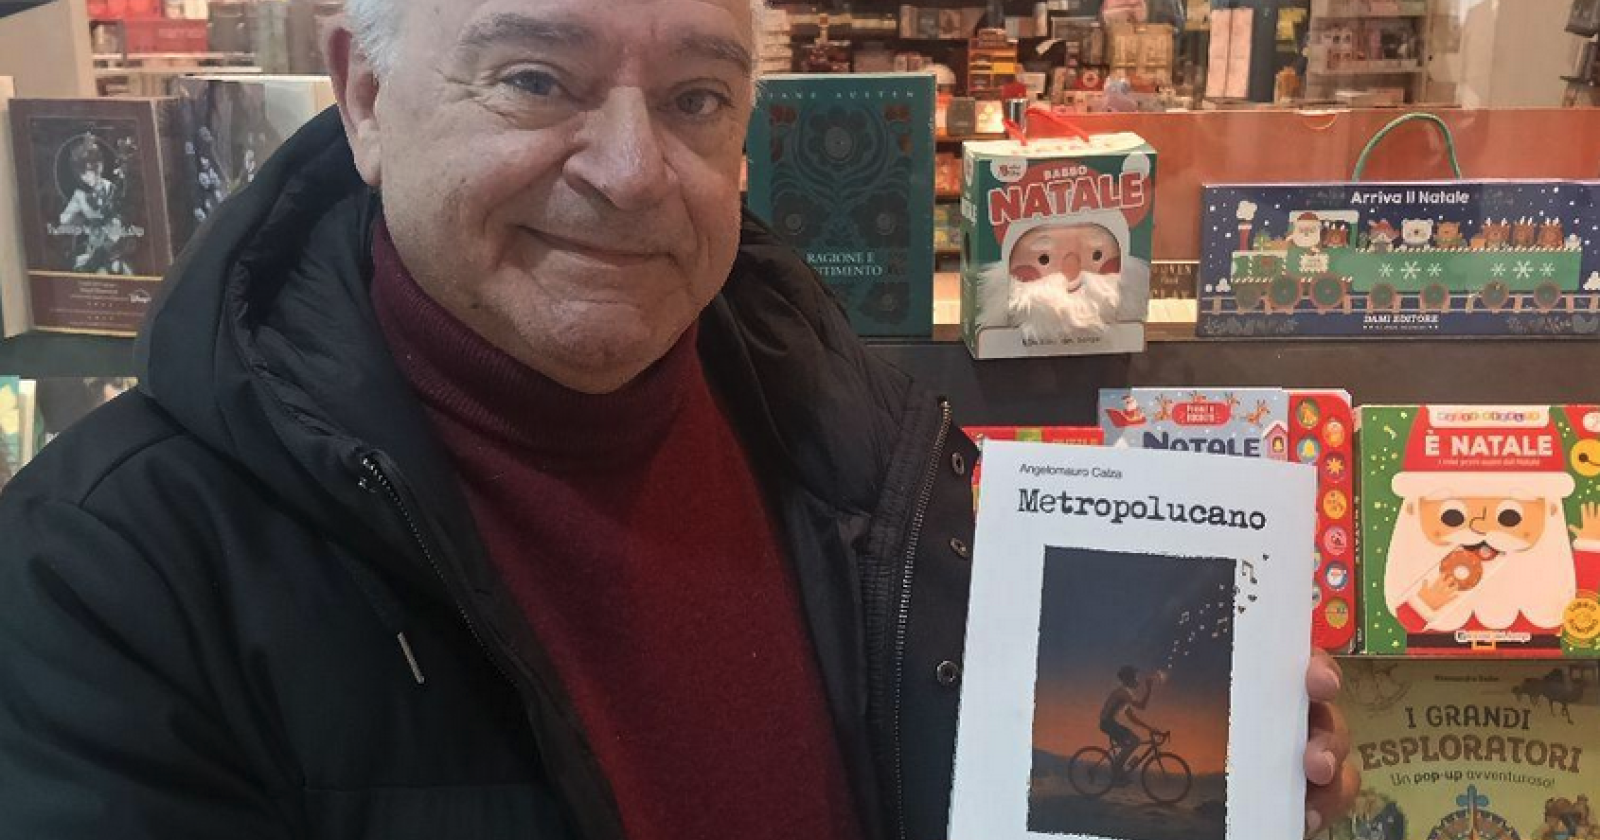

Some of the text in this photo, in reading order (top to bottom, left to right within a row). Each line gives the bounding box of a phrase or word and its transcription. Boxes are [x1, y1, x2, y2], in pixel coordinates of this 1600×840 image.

[836, 91, 914, 100] AUSTEN
[1043, 165, 1088, 180] BABBO
[989, 172, 1145, 226] NATALE
[1350, 190, 1402, 204] Arriva
[1418, 190, 1470, 204] Natale
[806, 251, 876, 263] RAGIONE E
[813, 265, 884, 276] NTIMENTO
[1363, 314, 1439, 323] DAMI EDITORE
[1425, 430, 1553, 457] È NATALE
[1019, 463, 1123, 479] Angelomauro Calza
[1017, 488, 1267, 531] Metropolucano
[1405, 705, 1531, 730] I GRANDI
[1358, 734, 1582, 773] ESPLORATORI
[1390, 770, 1555, 788] Un pop-up avventuroso!
